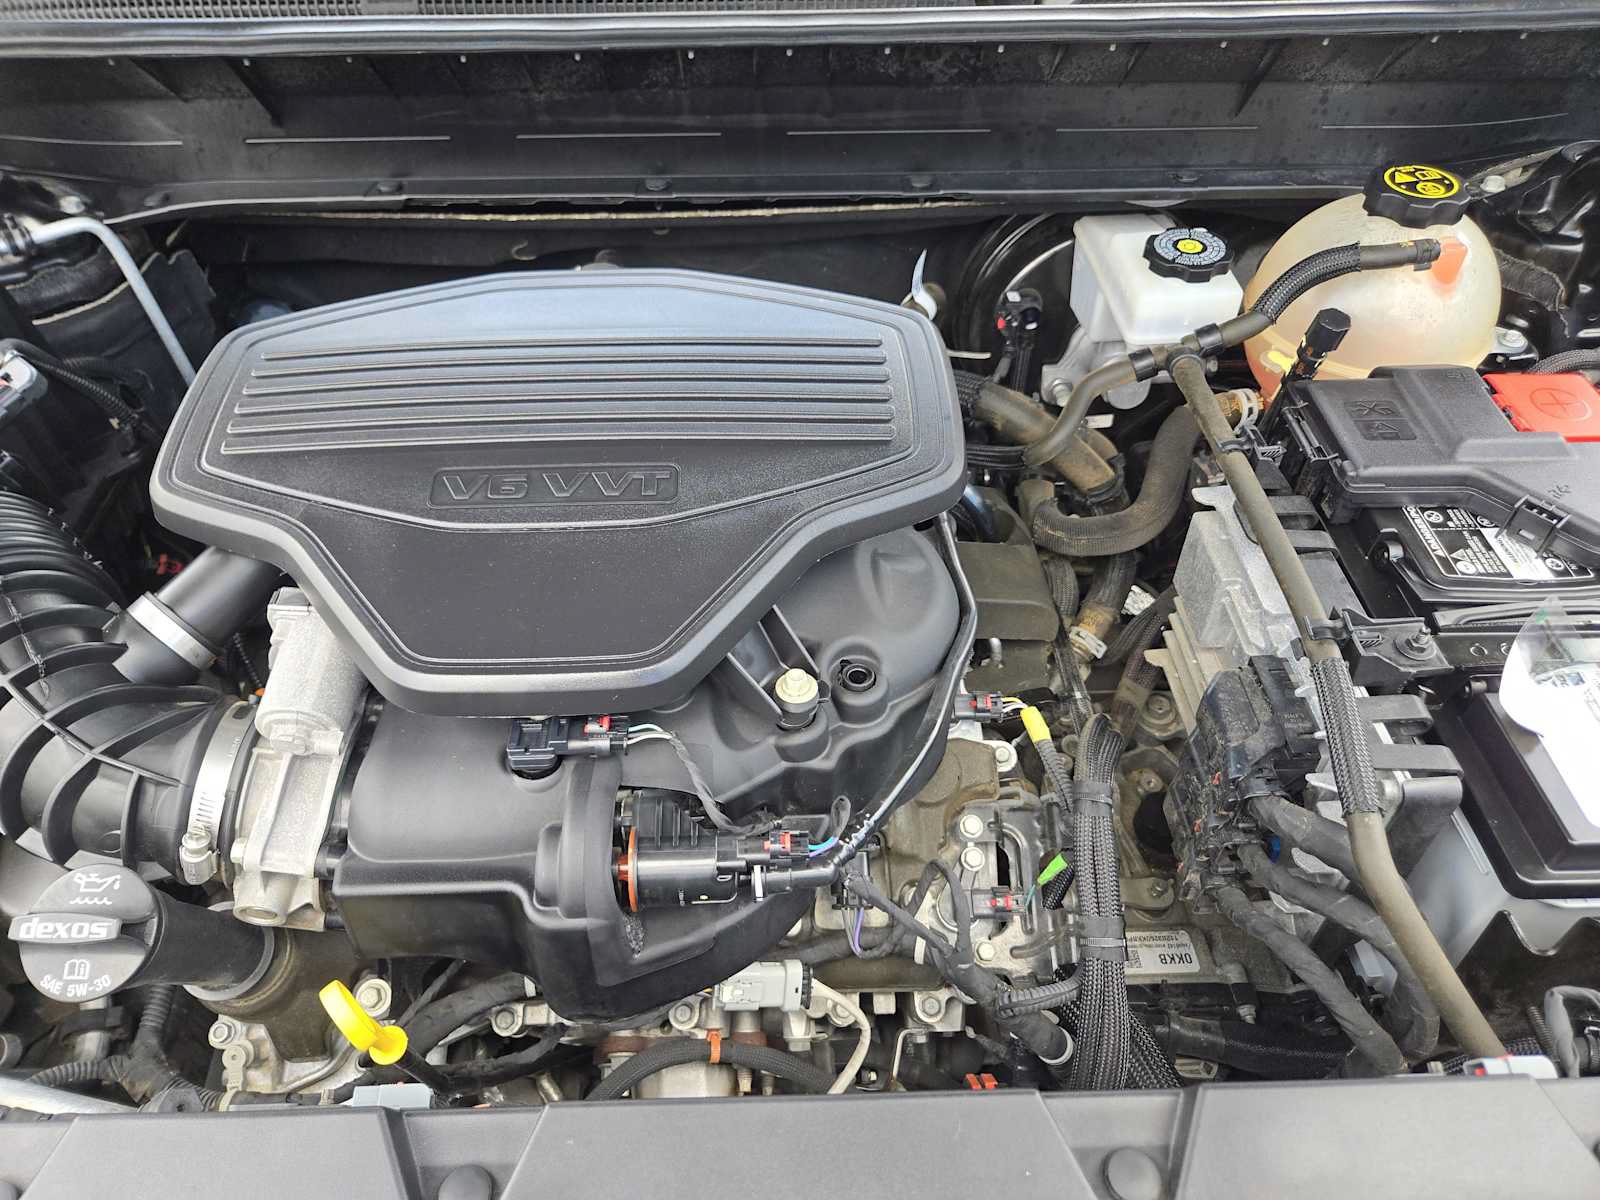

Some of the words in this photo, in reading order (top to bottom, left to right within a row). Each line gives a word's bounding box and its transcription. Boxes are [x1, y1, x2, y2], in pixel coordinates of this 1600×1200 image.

[442, 473, 528, 500] V6
[542, 471, 671, 497] VVT
[19, 917, 112, 939] dexos
[41, 975, 62, 994] SAE
[67, 974, 111, 997] 5W-30
